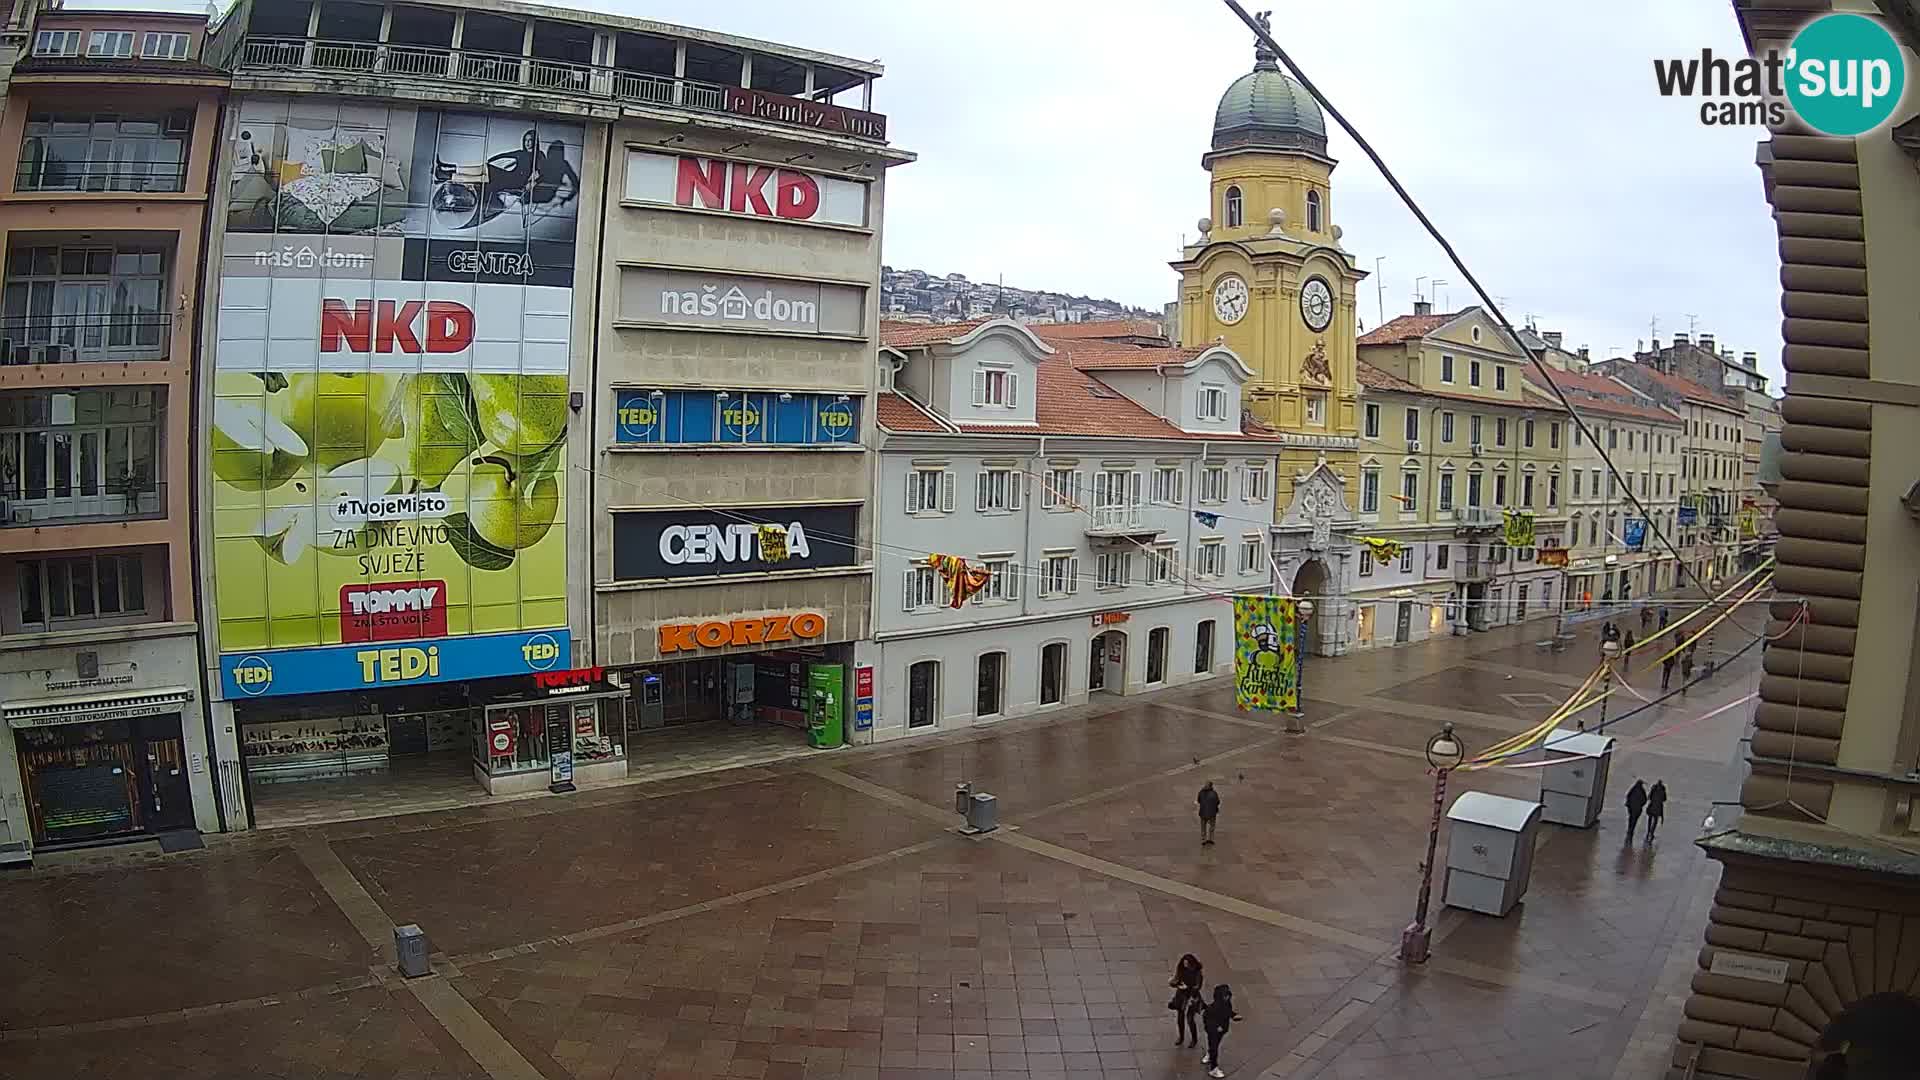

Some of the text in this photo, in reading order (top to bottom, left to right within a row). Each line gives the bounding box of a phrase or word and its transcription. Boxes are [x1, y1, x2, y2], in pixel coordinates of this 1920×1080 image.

[723, 89, 745, 112] Le
[675, 158, 820, 220] NKD
[254, 247, 365, 268] naš dom
[448, 250, 534, 276] CENTRA
[661, 284, 817, 324] naš dom
[319, 298, 477, 354] NKD
[618, 408, 658, 425] TEDi
[723, 410, 759, 426] TEDi
[819, 412, 853, 428] TEDi
[337, 498, 446, 517] #TvojeMisto
[333, 524, 450, 549] ZA DNEVNO
[358, 547, 426, 576] SVJEŽE
[348, 586, 438, 615] TOMMY
[379, 615, 399, 626] ŠTO
[659, 613, 826, 654] KORZO
[522, 643, 560, 661] TEDi
[233, 665, 273, 685] TEDi
[357, 646, 439, 683] TEDi
